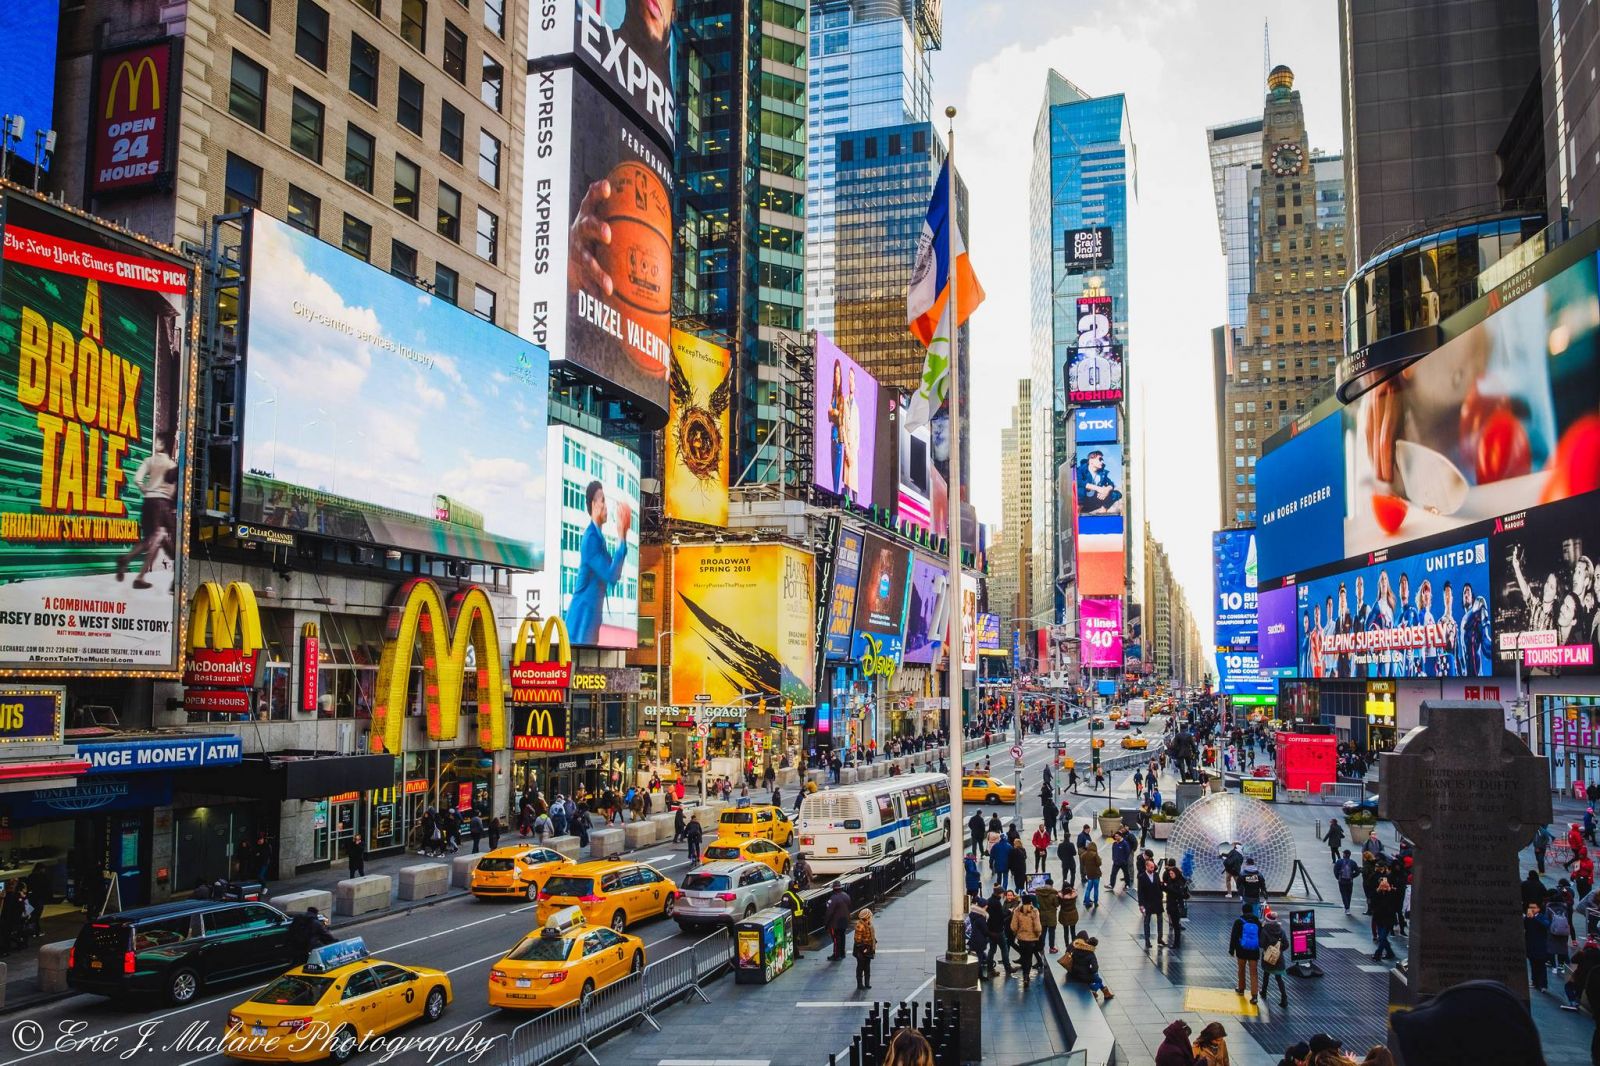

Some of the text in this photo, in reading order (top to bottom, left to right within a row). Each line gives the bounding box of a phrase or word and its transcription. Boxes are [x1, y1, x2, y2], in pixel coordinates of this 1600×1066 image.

[581, 2, 675, 141] EXPRE
[108, 117, 156, 138] OPEN
[112, 135, 149, 163] 24
[100, 161, 160, 183] HOURS
[534, 178, 551, 275] EXPRESS
[1074, 246, 1103, 254] Undr
[3, 232, 26, 251] The
[26, 238, 52, 258] New
[53, 245, 82, 265] York
[82, 252, 114, 273] Times
[162, 271, 188, 287] PICK
[1502, 266, 1537, 293] MARRIOTT
[1502, 280, 1533, 303] MARQUIS
[81, 278, 102, 341] A
[578, 289, 624, 341] DENZEL
[292, 300, 436, 371] City-centric services Industry
[18, 306, 141, 440] BRONX
[1069, 390, 1123, 401] TOSHIBA
[1086, 420, 1115, 430] TDK
[37, 412, 126, 515] TALE
[1262, 486, 1332, 526] CAN ROGER FEDERER
[1504, 511, 1527, 522] MARRIOTT
[1, 511, 140, 541] BROADWAY'S NEW HIT MUSICAL
[700, 558, 750, 566] BROADWAY
[733, 565, 752, 573] 2018
[785, 556, 811, 581] HARRY
[1426, 549, 1475, 572] UNITED
[783, 576, 813, 602] POTTER
[53, 600, 116, 614] COMBINATION
[116, 602, 128, 614] OF
[1220, 592, 1243, 610] 10
[34, 613, 66, 627] BOYS
[67, 614, 77, 627] &
[79, 615, 110, 629] WEST
[111, 618, 135, 631] SIDE
[1086, 618, 1118, 628] 4 lines
[1321, 623, 1449, 652] HELPING SUPERHEROES FLY
[1502, 633, 1556, 646] STAY CONNECTED
[1224, 655, 1242, 668] 10
[1500, 647, 1589, 664] WITH TE TOURIST PLAN
[185, 660, 252, 674] McDonald's
[512, 669, 567, 679] McDonald's
[194, 674, 242, 683] Restaurant
[185, 696, 246, 706] OPEN 24 HOURS
[644, 705, 747, 718] GIFTS LGGAGE
[75, 744, 239, 768] ANGE MONEY ATM
[559, 760, 577, 769] EXPRESS
[1554, 758, 1600, 769] WRLES
[34, 782, 129, 800] MONEY EXCHANGE
